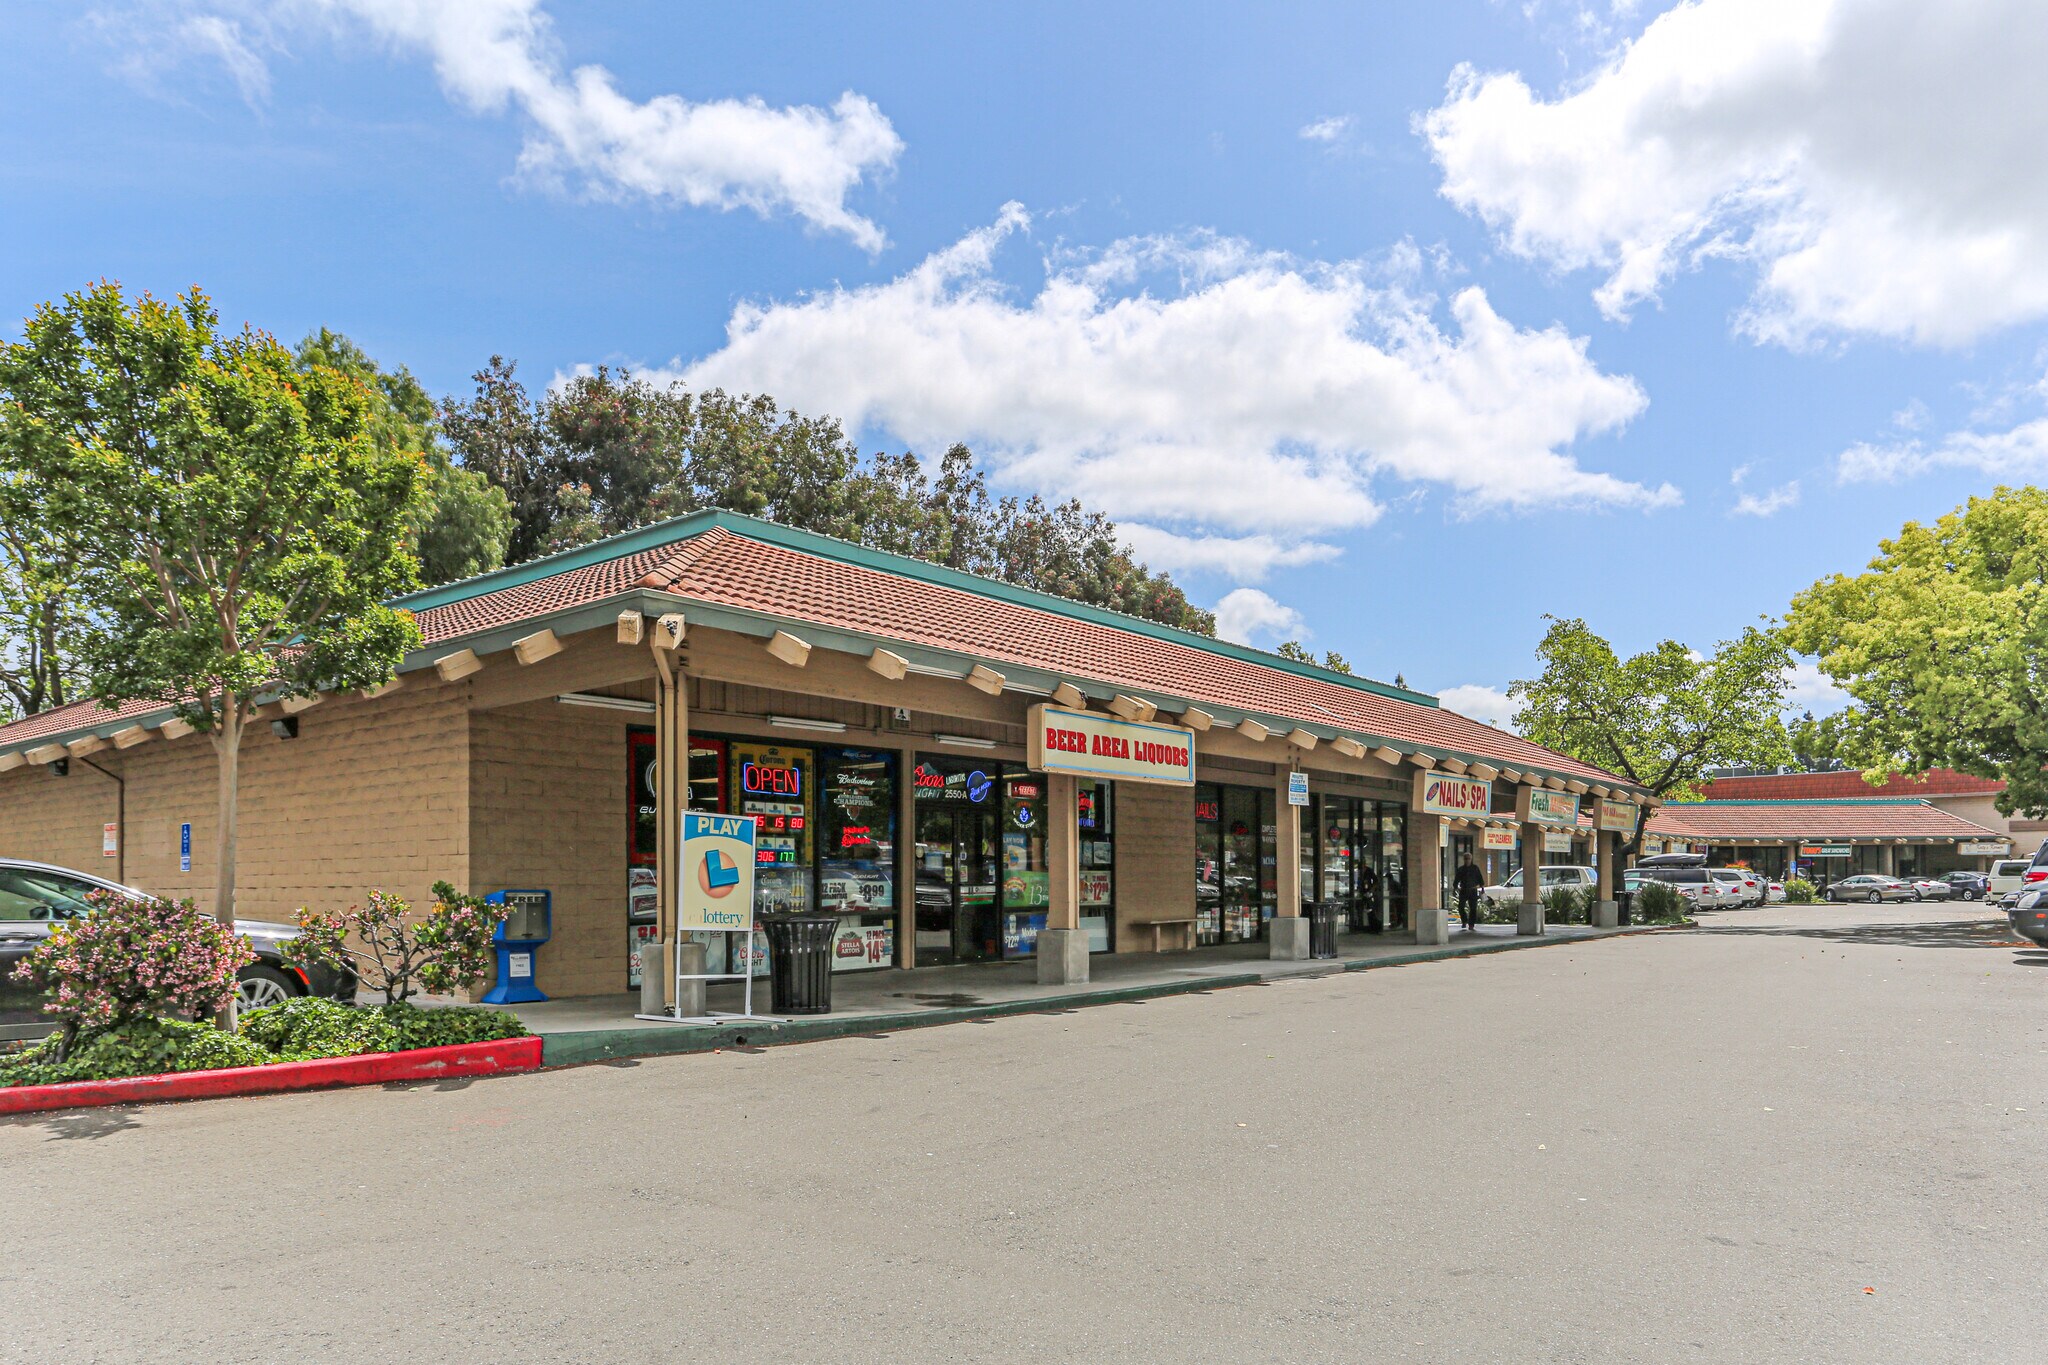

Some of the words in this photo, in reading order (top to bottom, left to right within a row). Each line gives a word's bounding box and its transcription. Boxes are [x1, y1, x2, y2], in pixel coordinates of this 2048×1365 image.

[1046, 727, 1087, 754] BEER
[1092, 734, 1130, 760] AREA
[1134, 740, 1189, 768] LIQUORS
[746, 766, 798, 794] OPEN
[913, 765, 945, 788] Coors
[944, 789, 968, 799] 2550-A
[1439, 780, 1467, 809] NAILS
[1470, 784, 1487, 811] SPA
[1531, 793, 1550, 812] Fresh
[697, 816, 743, 836] PLAY
[791, 818, 803, 829] 80
[757, 851, 775, 862] 306
[780, 852, 795, 862] 177
[703, 908, 744, 928] lottery
